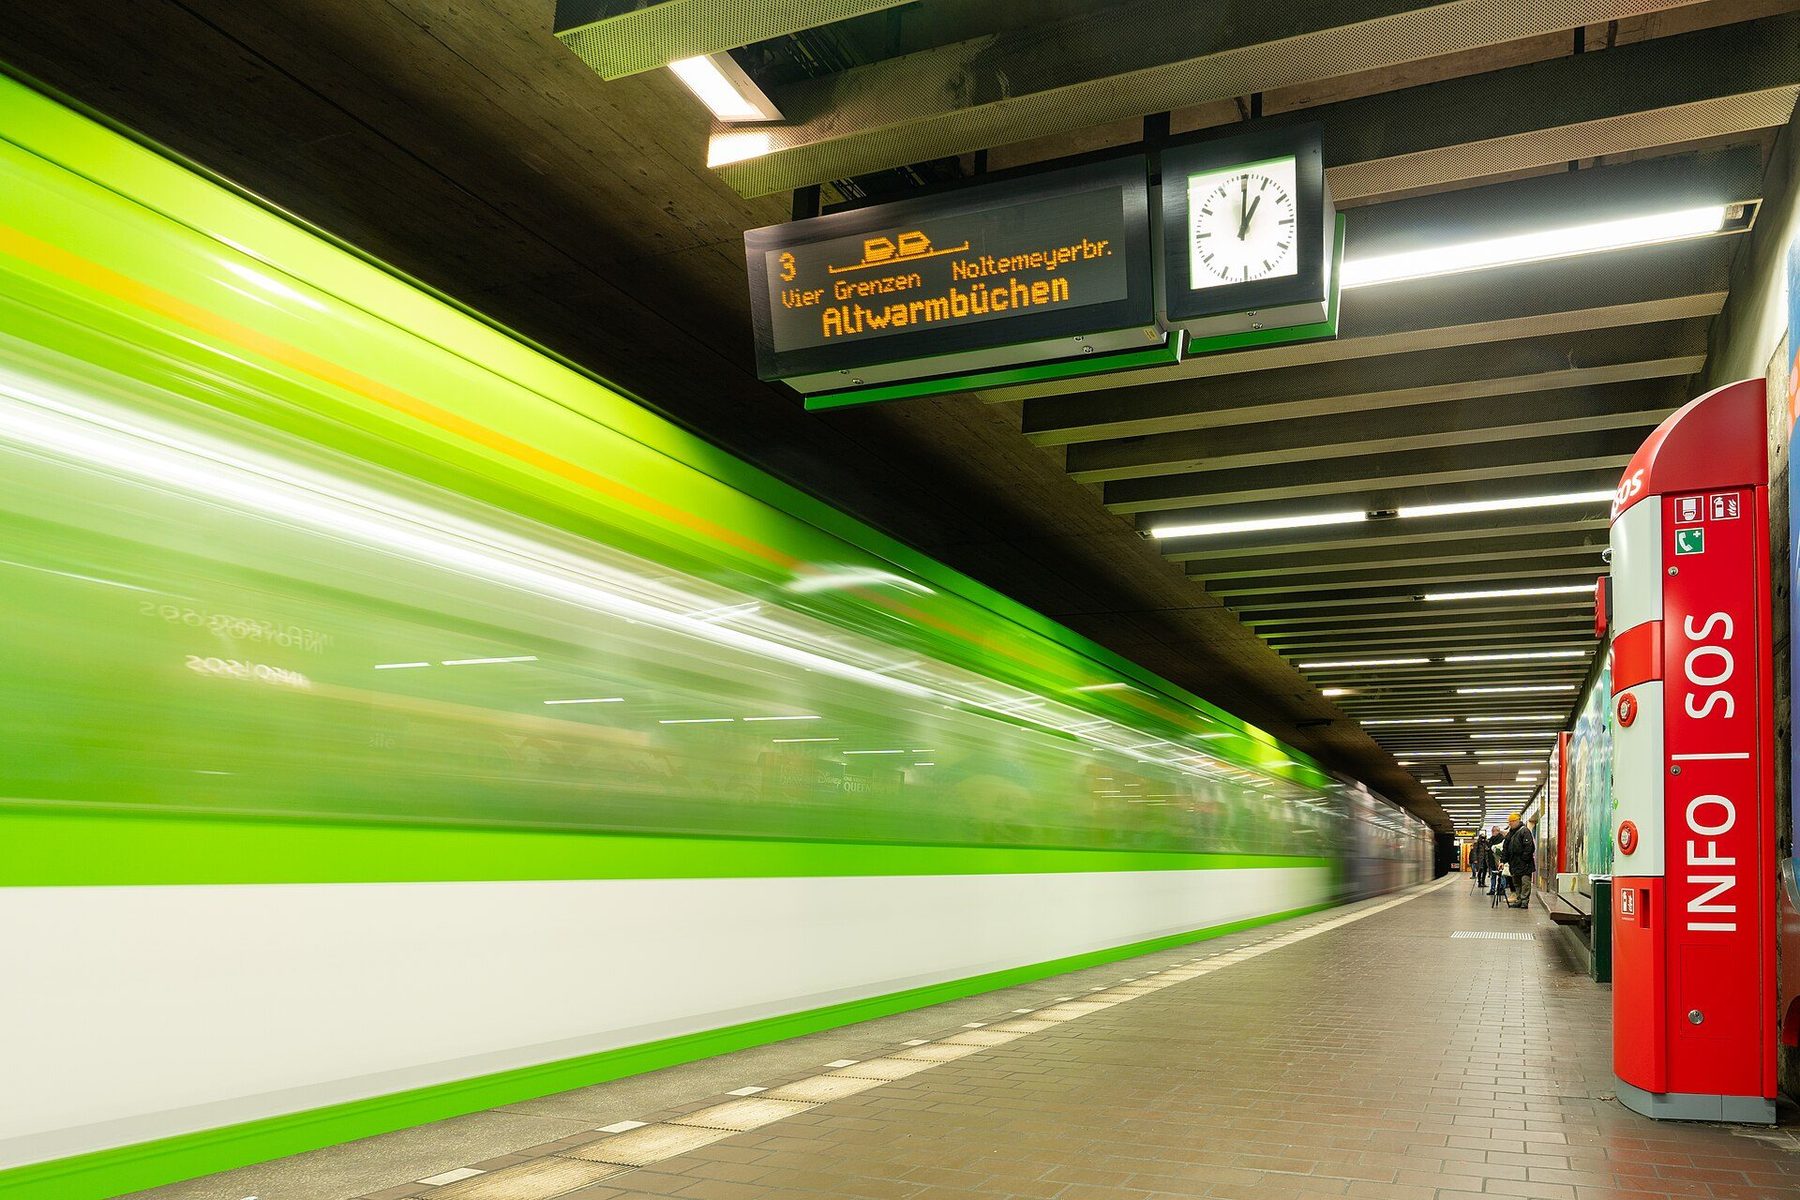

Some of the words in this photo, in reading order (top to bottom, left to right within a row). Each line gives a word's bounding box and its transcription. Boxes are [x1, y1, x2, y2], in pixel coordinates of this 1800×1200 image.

[779, 251, 797, 282] 3
[781, 288, 825, 309] Vier
[834, 272, 923, 300] Grenzen
[952, 237, 1112, 281] Noltemeyerbr.
[822, 276, 1069, 337] Altwarmbüchen
[1683, 611, 1734, 719] SOS
[1685, 793, 1737, 932] INFO
